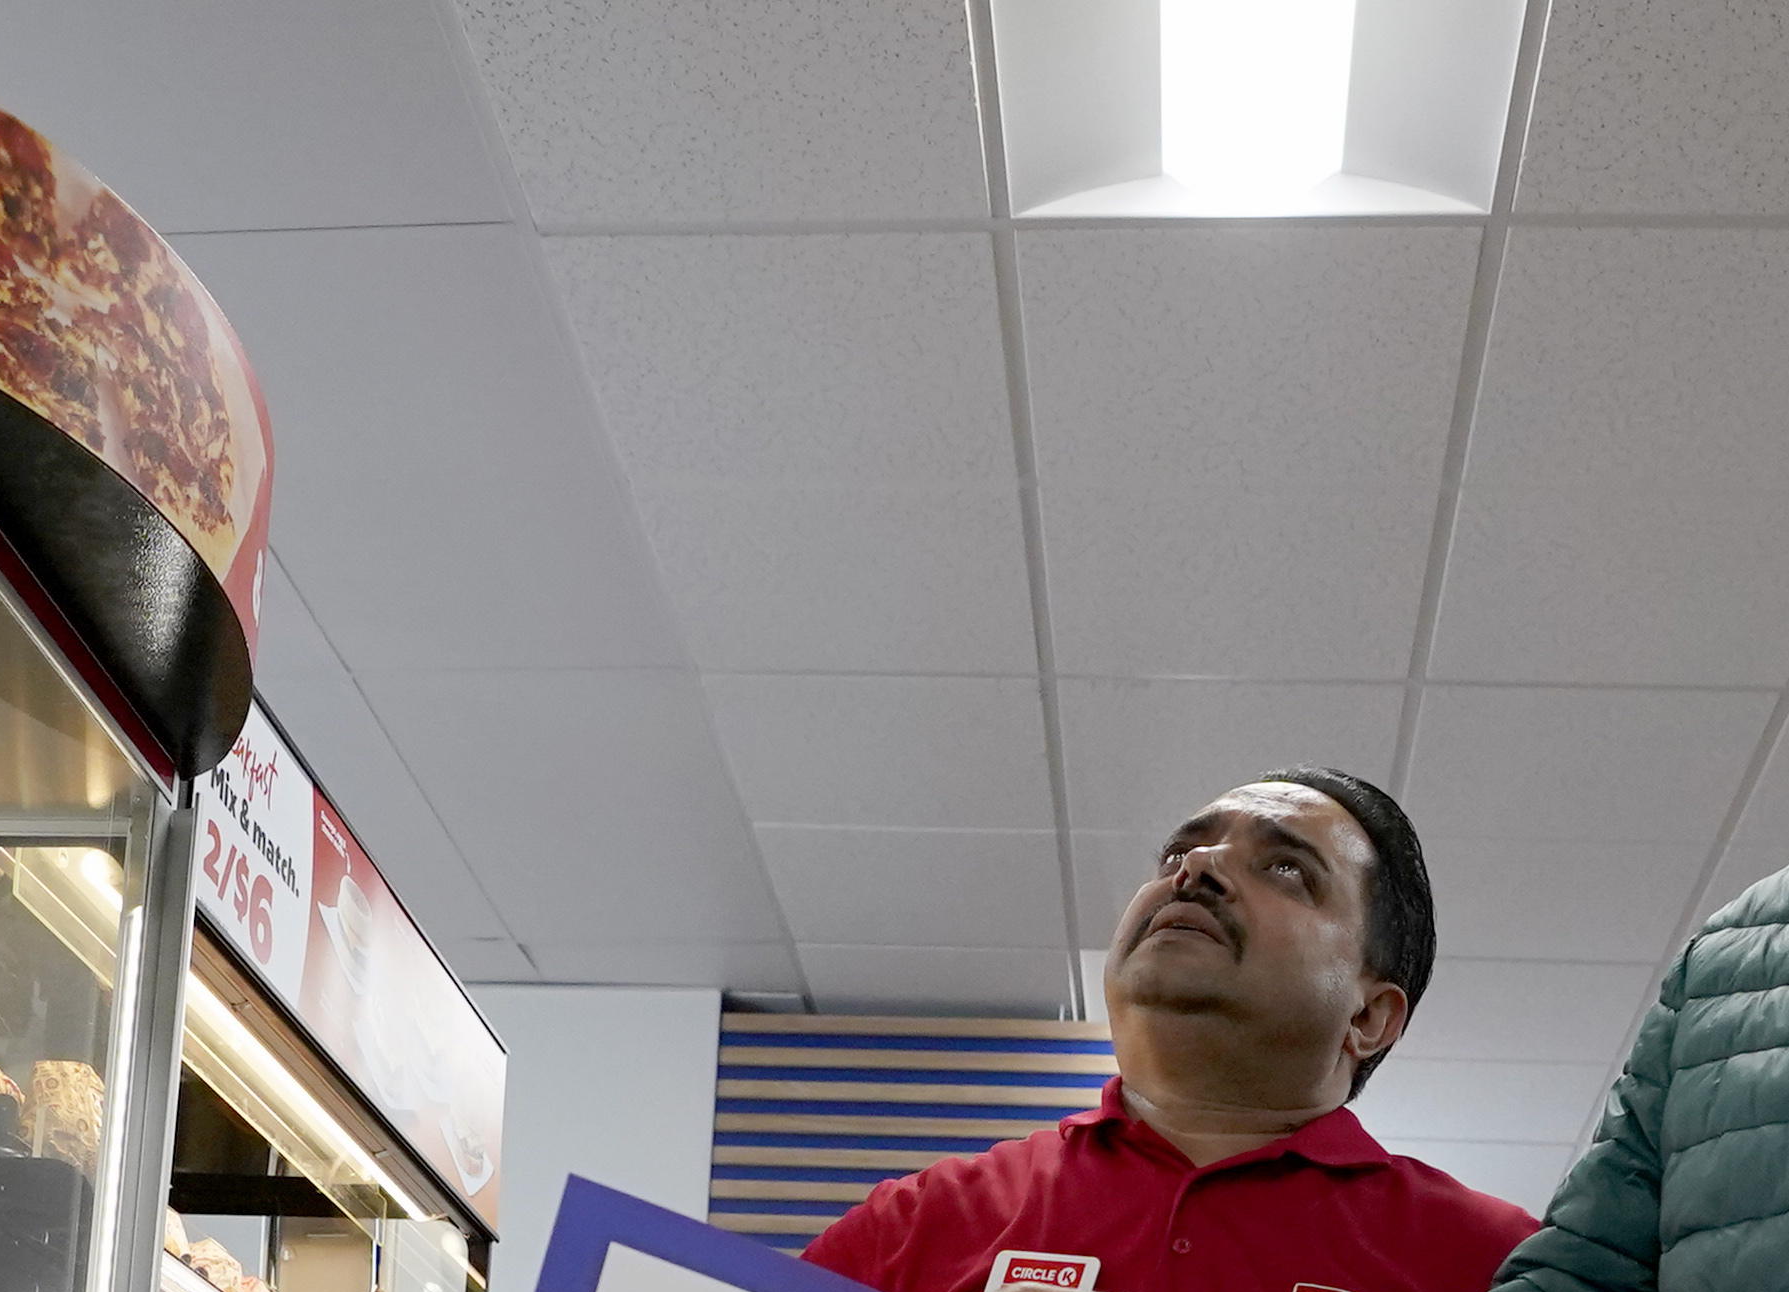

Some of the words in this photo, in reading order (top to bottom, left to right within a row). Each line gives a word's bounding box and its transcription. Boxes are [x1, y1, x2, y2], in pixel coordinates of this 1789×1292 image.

[203, 819, 273, 965] 2/$6
[211, 765, 236, 819] Mix
[239, 799, 249, 835] &
[253, 821, 299, 898] match.
[1012, 1266, 1056, 1282] CIRCLE
[1059, 1266, 1076, 1286] K
